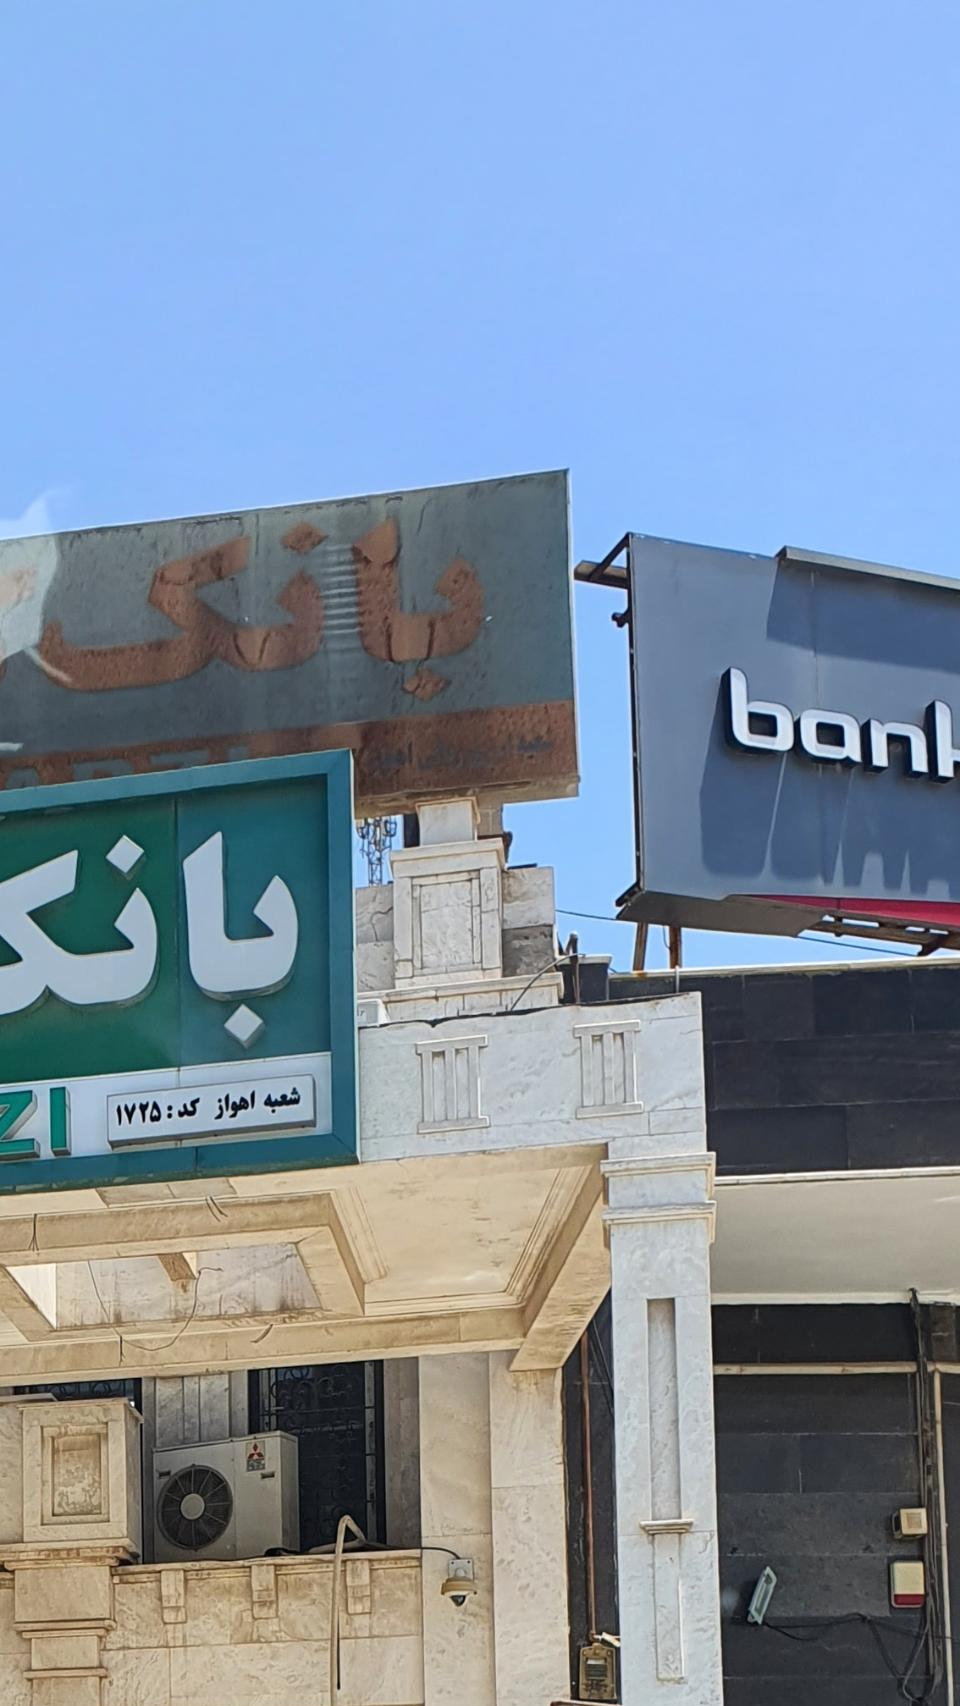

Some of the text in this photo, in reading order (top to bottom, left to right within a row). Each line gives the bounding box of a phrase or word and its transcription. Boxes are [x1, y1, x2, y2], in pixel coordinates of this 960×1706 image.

[38, 518, 483, 700] بانک
[214, 1090, 256, 1120] اهواز
[263, 1086, 301, 1113] شعبه
